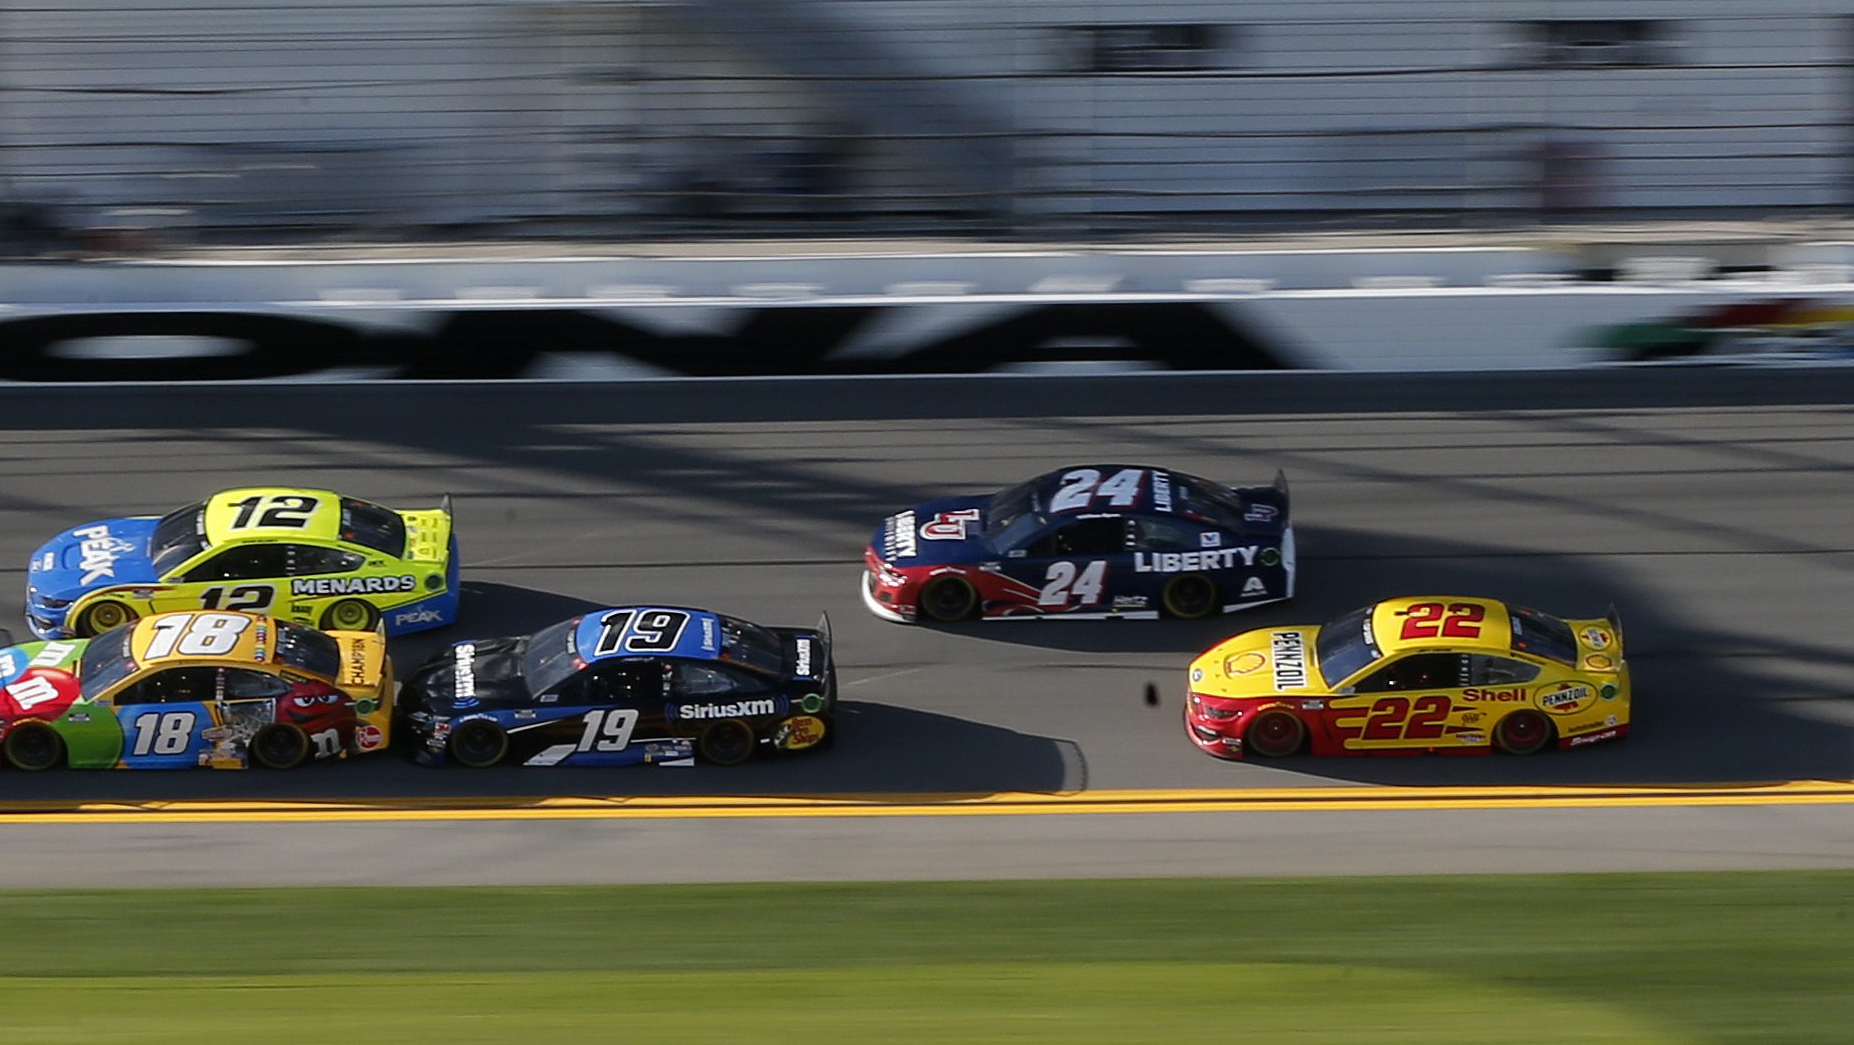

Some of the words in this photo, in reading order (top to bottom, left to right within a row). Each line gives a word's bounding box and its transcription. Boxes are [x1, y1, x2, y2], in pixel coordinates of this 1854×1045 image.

[233, 496, 318, 529] 12
[1050, 469, 1143, 513] 24
[1152, 471, 1172, 512] LIBERTY
[73, 526, 115, 586] PEAK
[1134, 546, 1259, 572] LIBERTY
[292, 575, 416, 596] MENARDS
[1038, 560, 1106, 604] 24
[143, 613, 252, 661] 18
[395, 610, 442, 626] PEAK
[594, 608, 690, 656] 19
[1401, 603, 1485, 639] 22
[1272, 632, 1305, 690] PENNZOIL
[1463, 688, 1526, 702] Shell
[1542, 687, 1589, 706] PENNZOIL
[133, 712, 197, 756] 18
[577, 709, 639, 752] 19
[1363, 696, 1451, 740] 22
